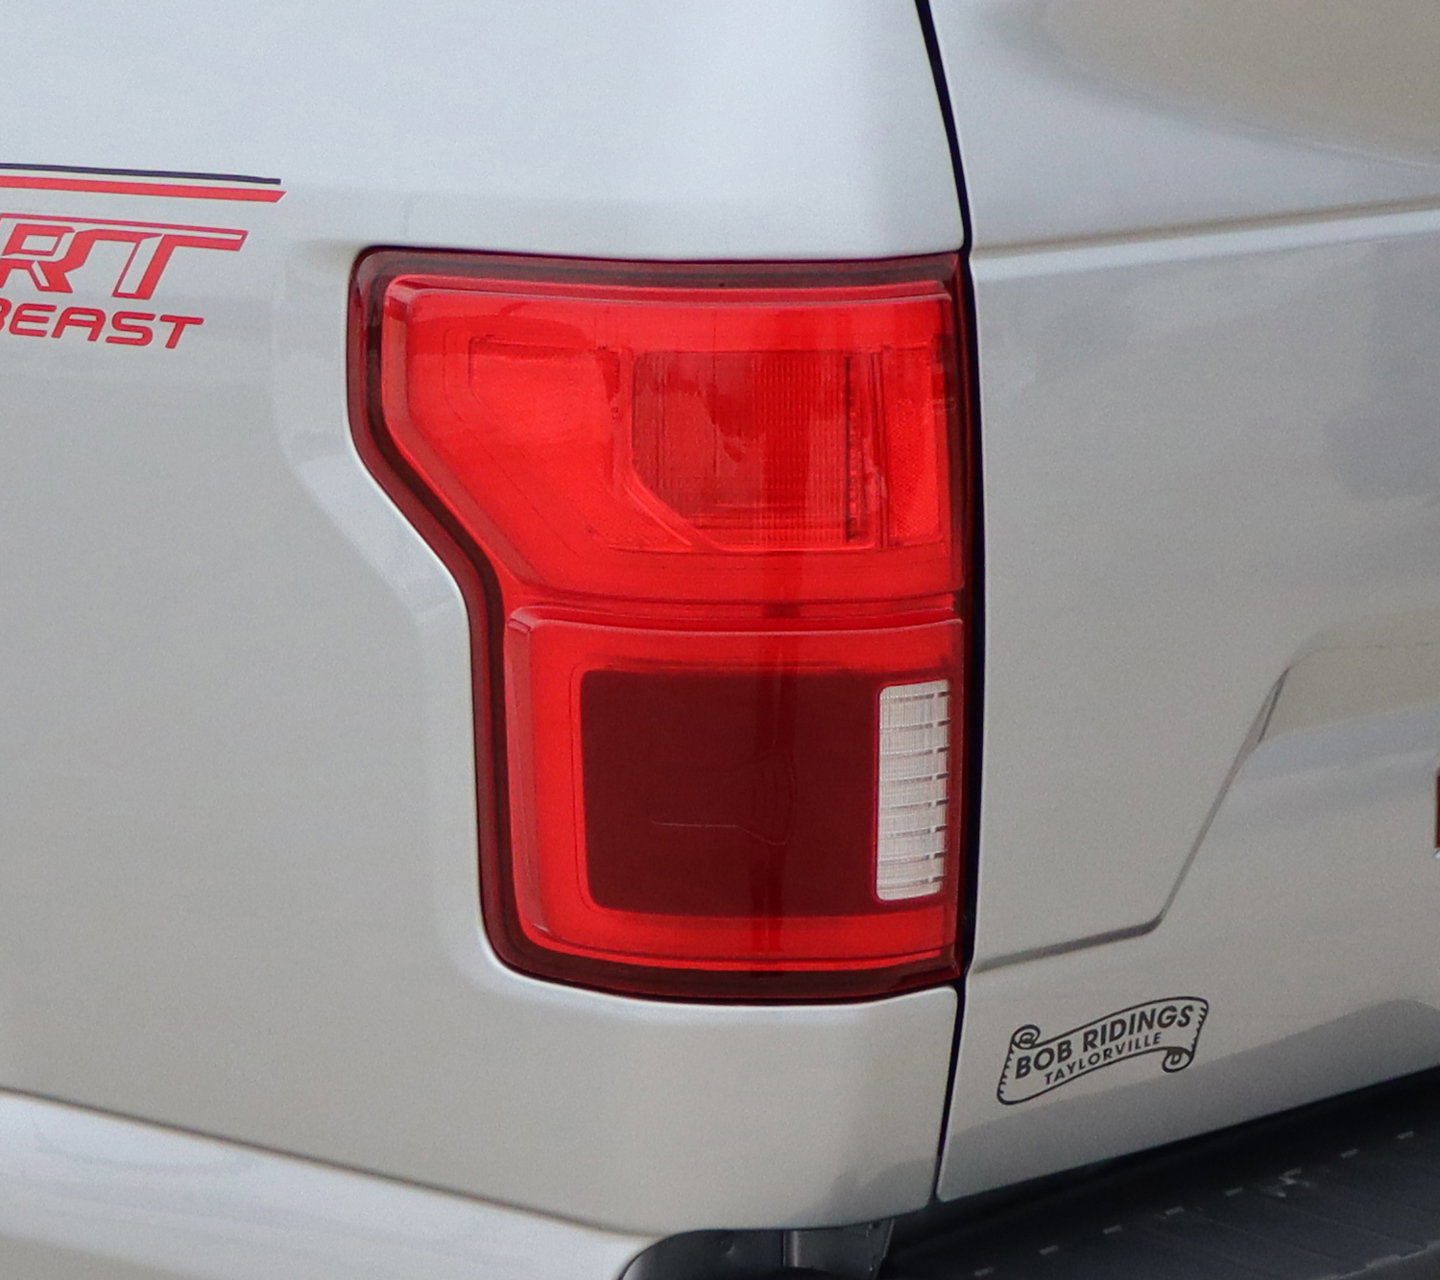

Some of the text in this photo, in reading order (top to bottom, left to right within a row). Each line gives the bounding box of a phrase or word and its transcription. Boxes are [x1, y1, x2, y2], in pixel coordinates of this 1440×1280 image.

[1015, 1004, 1195, 1080] BOB RIDINGS
[1044, 1032, 1162, 1086] TAYLORVILLE
